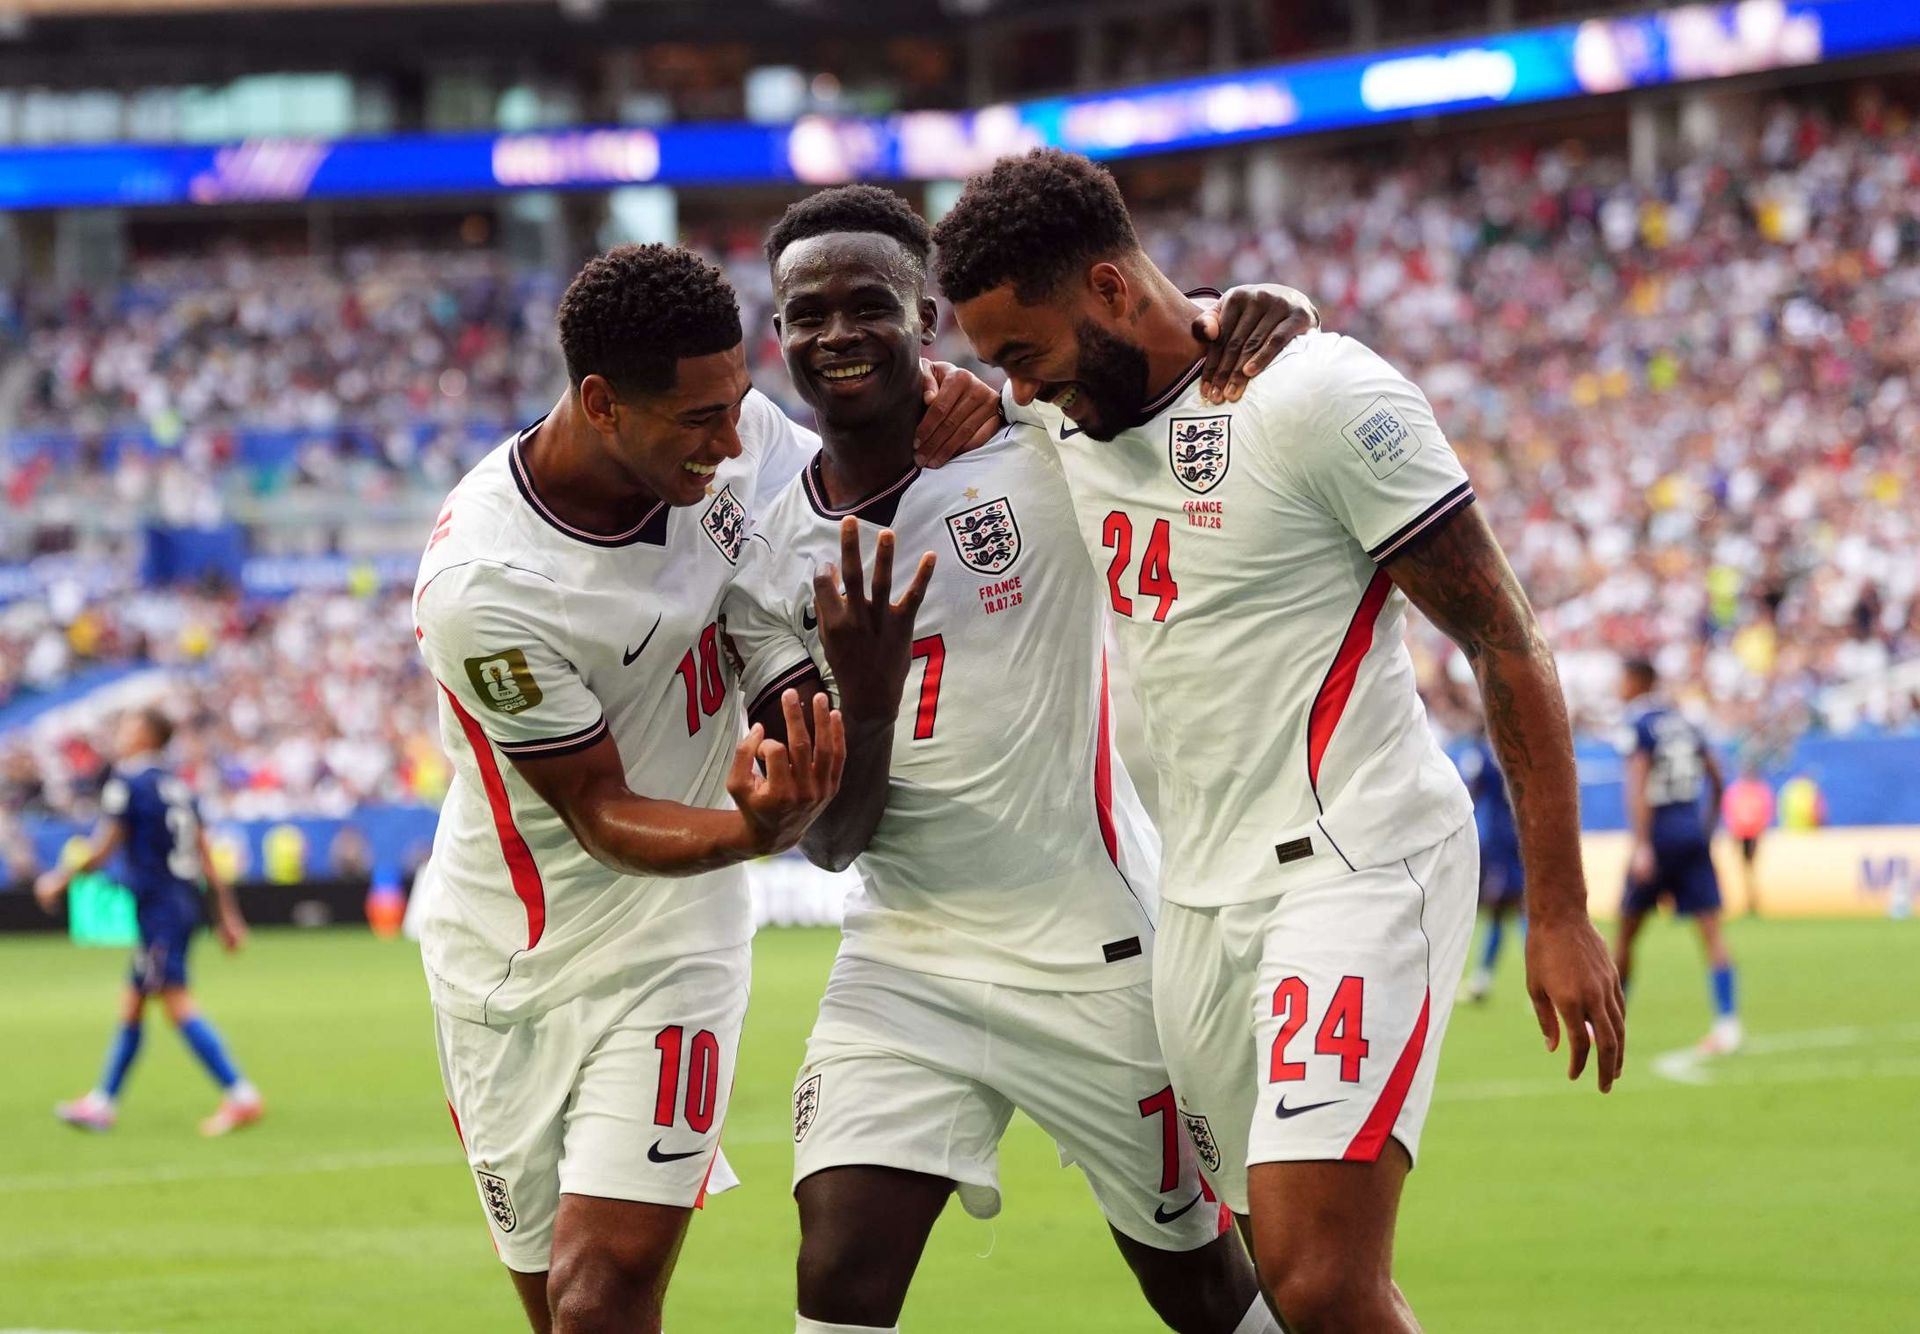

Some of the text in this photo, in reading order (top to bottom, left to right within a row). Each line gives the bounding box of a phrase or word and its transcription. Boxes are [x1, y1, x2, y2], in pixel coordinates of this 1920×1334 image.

[1353, 408, 1390, 440] FOOTBALL
[1361, 416, 1400, 451] UNITES
[1370, 427, 1409, 463] the World
[1388, 448, 1404, 462] FIFA
[1182, 501, 1223, 514] FRANCE
[1188, 513, 1221, 529] 18.07.26
[1102, 510, 1178, 623] 24
[979, 576, 1023, 600] FRANCE
[984, 592, 1023, 615] 18.07.26
[675, 621, 726, 738] 10
[911, 633, 946, 741] 7
[1269, 975, 1369, 1084] 24
[653, 1024, 720, 1135] 10
[1138, 1083, 1179, 1194] 7
